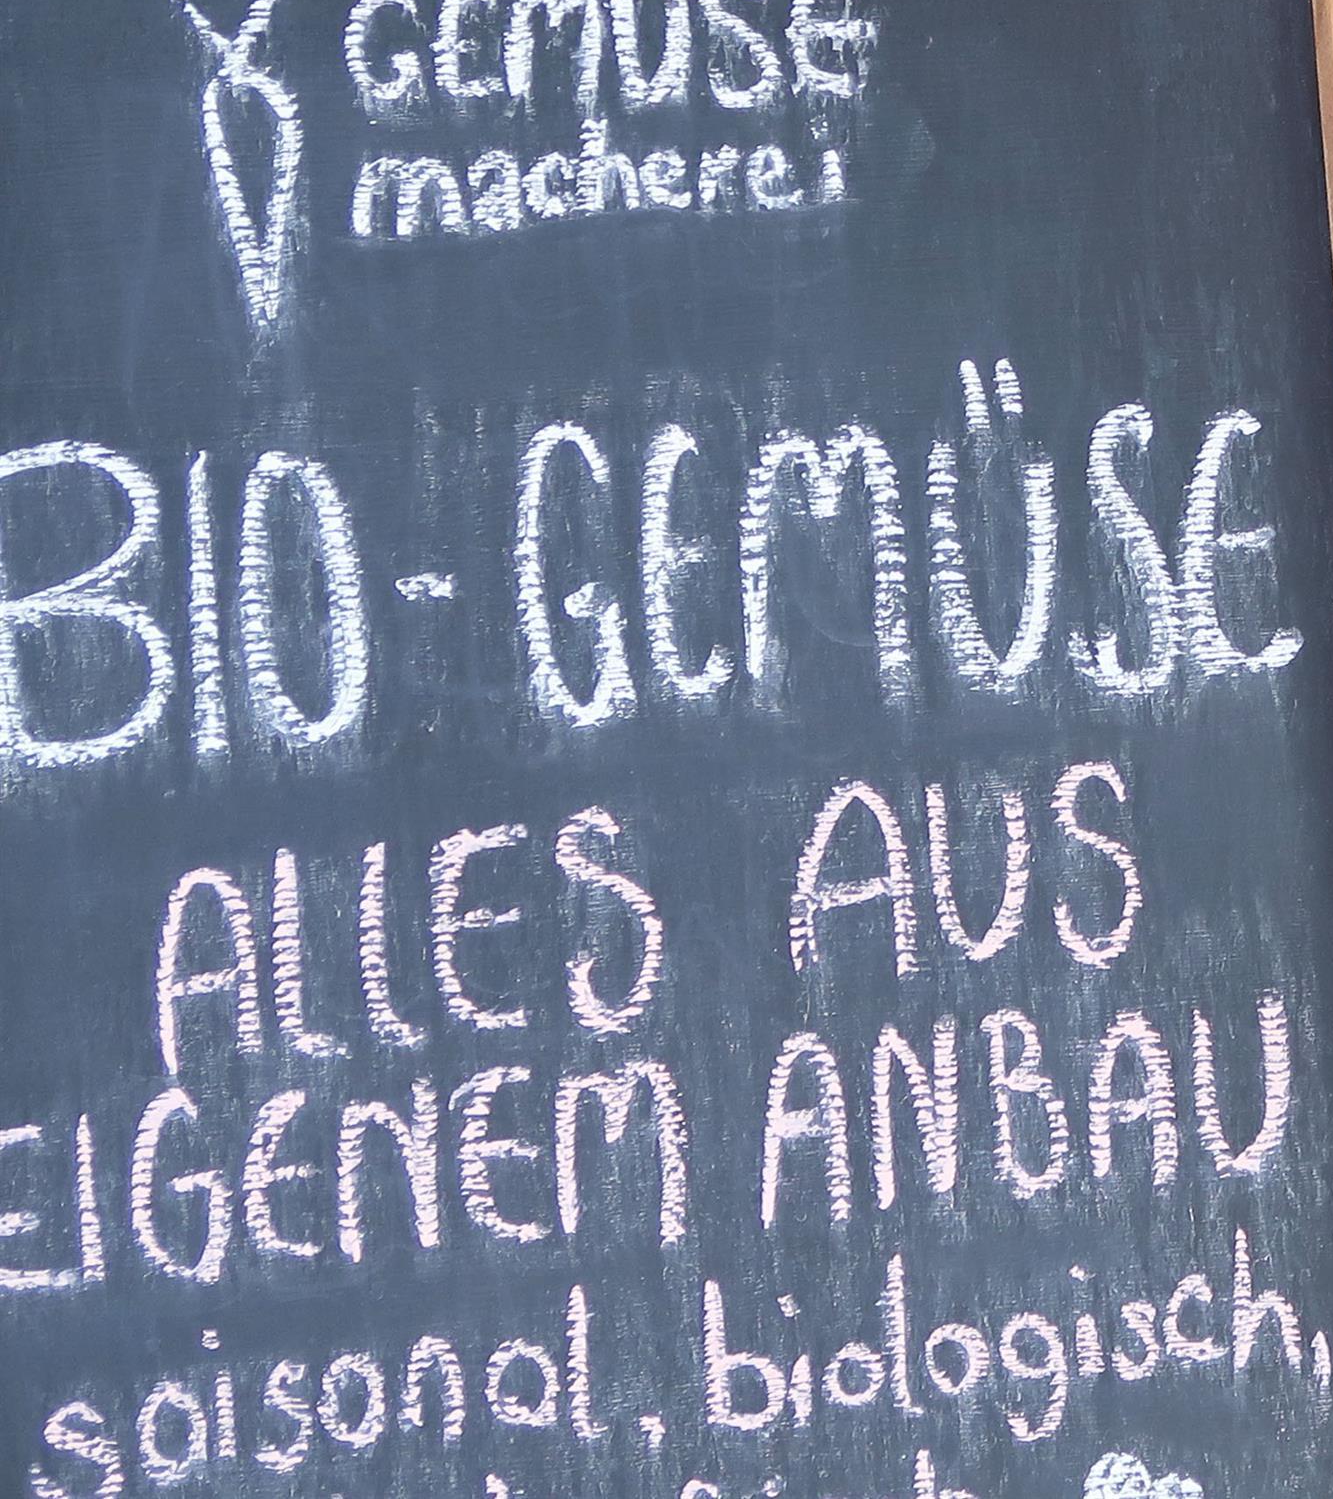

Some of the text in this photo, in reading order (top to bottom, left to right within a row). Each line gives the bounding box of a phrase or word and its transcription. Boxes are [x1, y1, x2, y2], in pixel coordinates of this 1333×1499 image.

[350, 117, 848, 238] macherei
[155, 761, 1142, 1076] ALLES AUS
[0, 990, 1292, 1288] EIGENEM ANBAU
